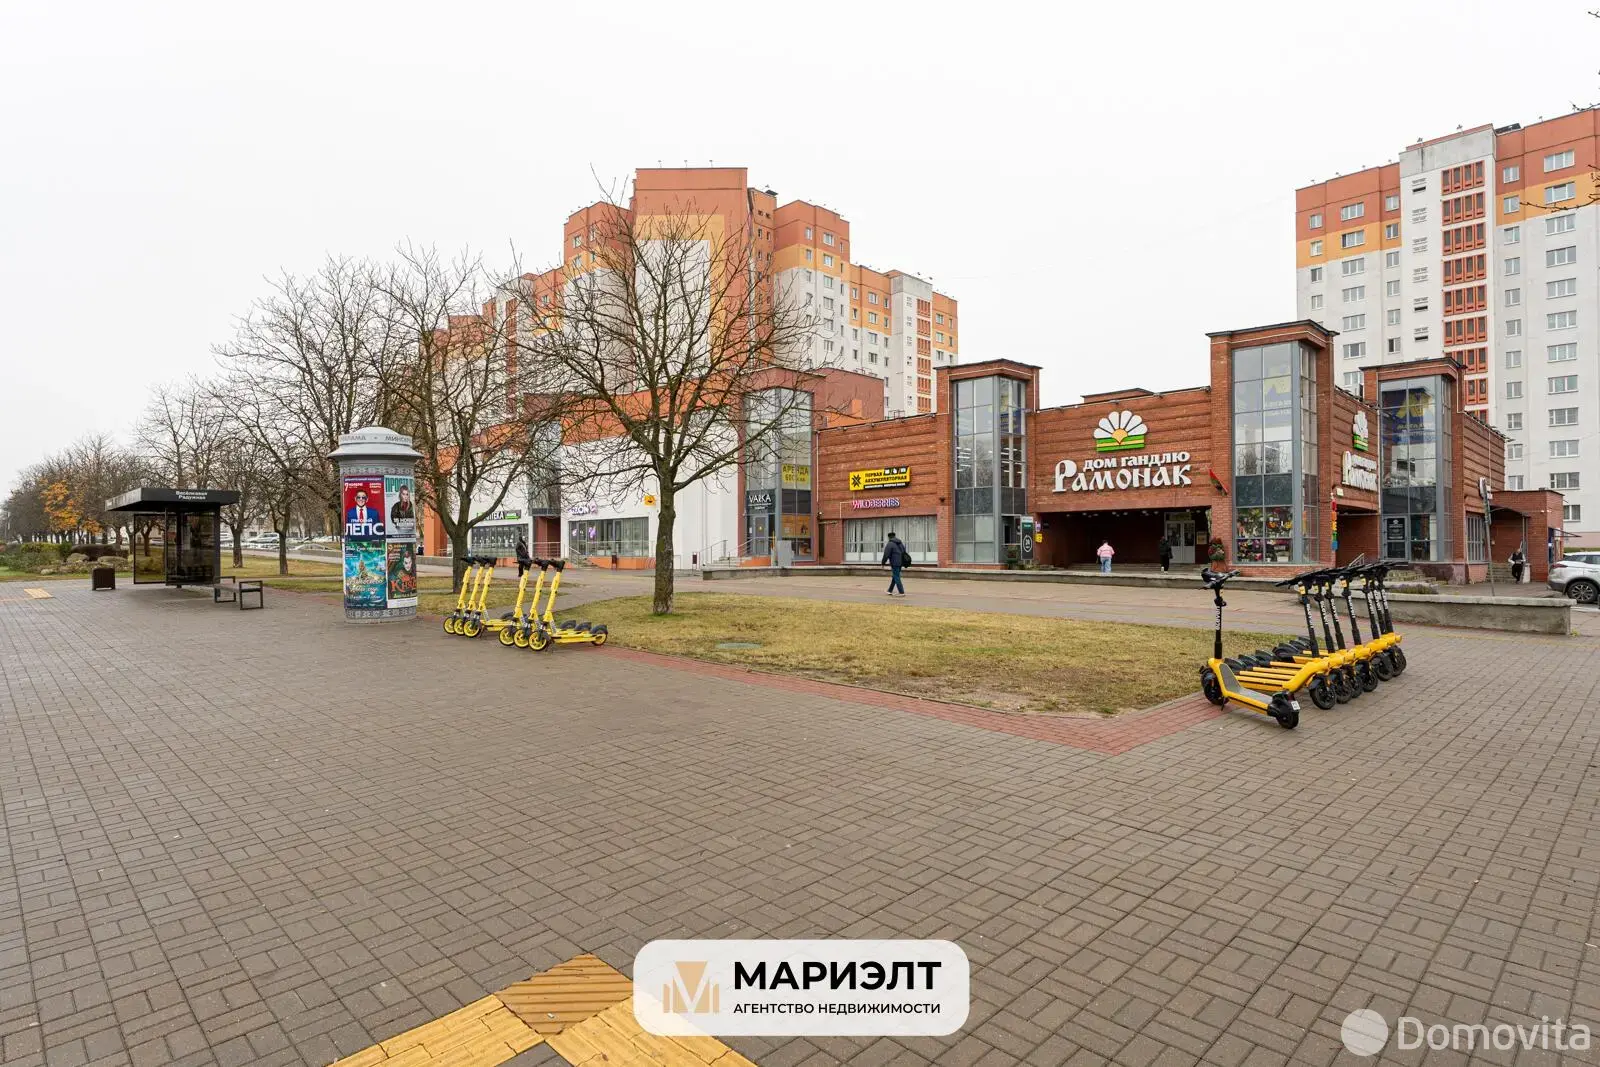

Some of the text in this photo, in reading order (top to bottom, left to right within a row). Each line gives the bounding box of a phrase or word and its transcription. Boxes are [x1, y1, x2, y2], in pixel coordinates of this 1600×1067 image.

[1082, 451, 1191, 473] дом гандлю
[345, 522, 385, 536] ЛЕПС
